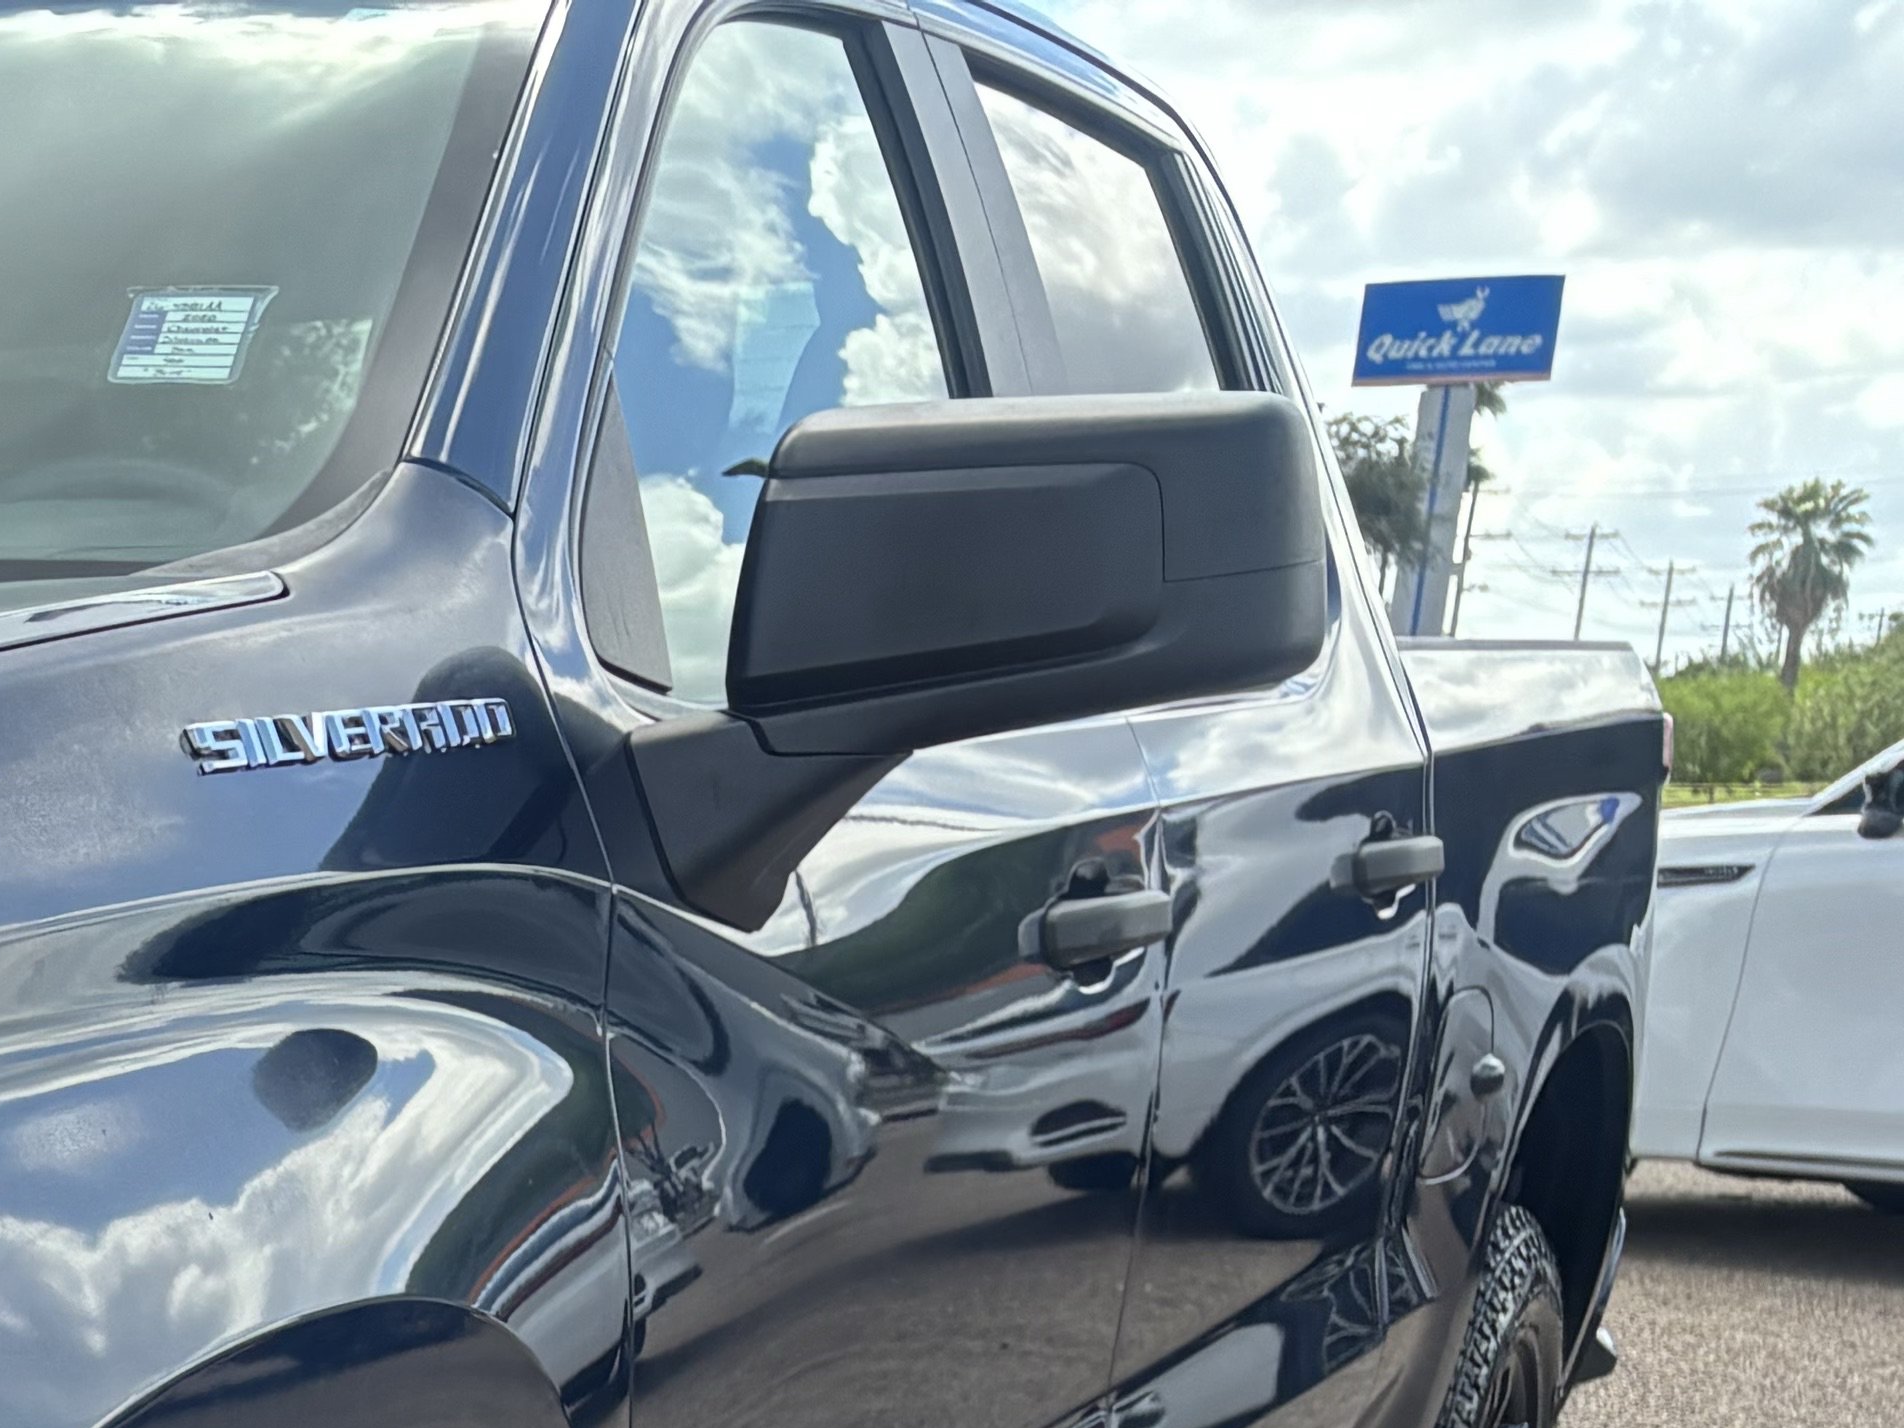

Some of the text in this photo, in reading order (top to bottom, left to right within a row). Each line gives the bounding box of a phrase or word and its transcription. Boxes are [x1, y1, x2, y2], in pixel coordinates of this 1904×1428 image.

[1366, 329, 1542, 364] Quick Lane
[180, 697, 516, 776] SILVERADO
